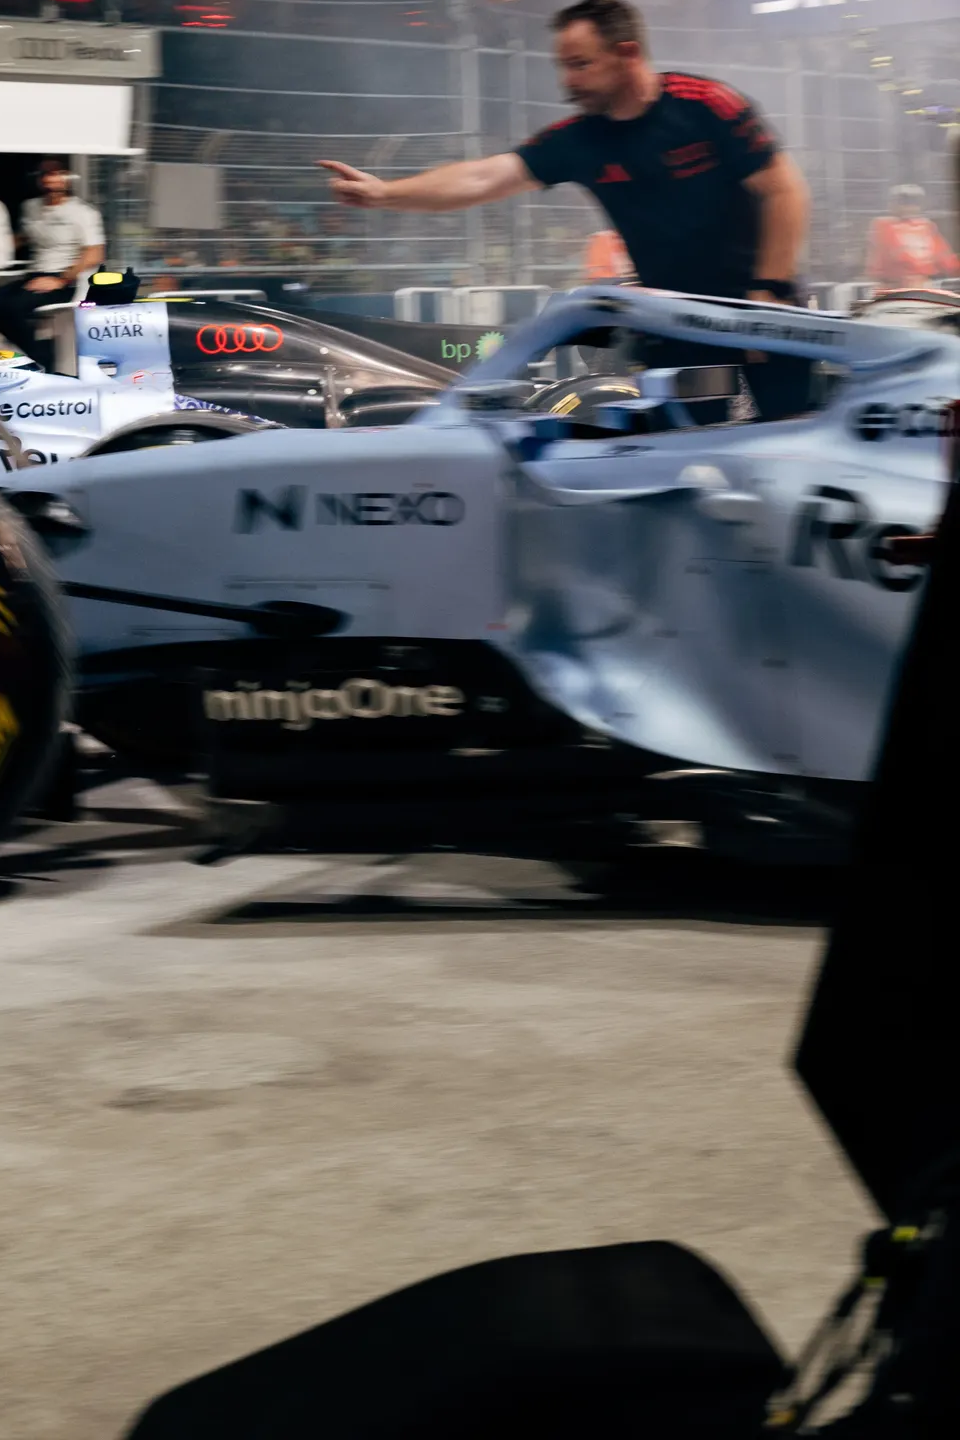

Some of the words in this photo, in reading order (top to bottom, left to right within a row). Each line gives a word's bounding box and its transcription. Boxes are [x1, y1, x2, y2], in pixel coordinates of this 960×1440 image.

[88, 324, 144, 341] QATAR
[441, 339, 471, 363] bp
[16, 398, 93, 418] Castrol
